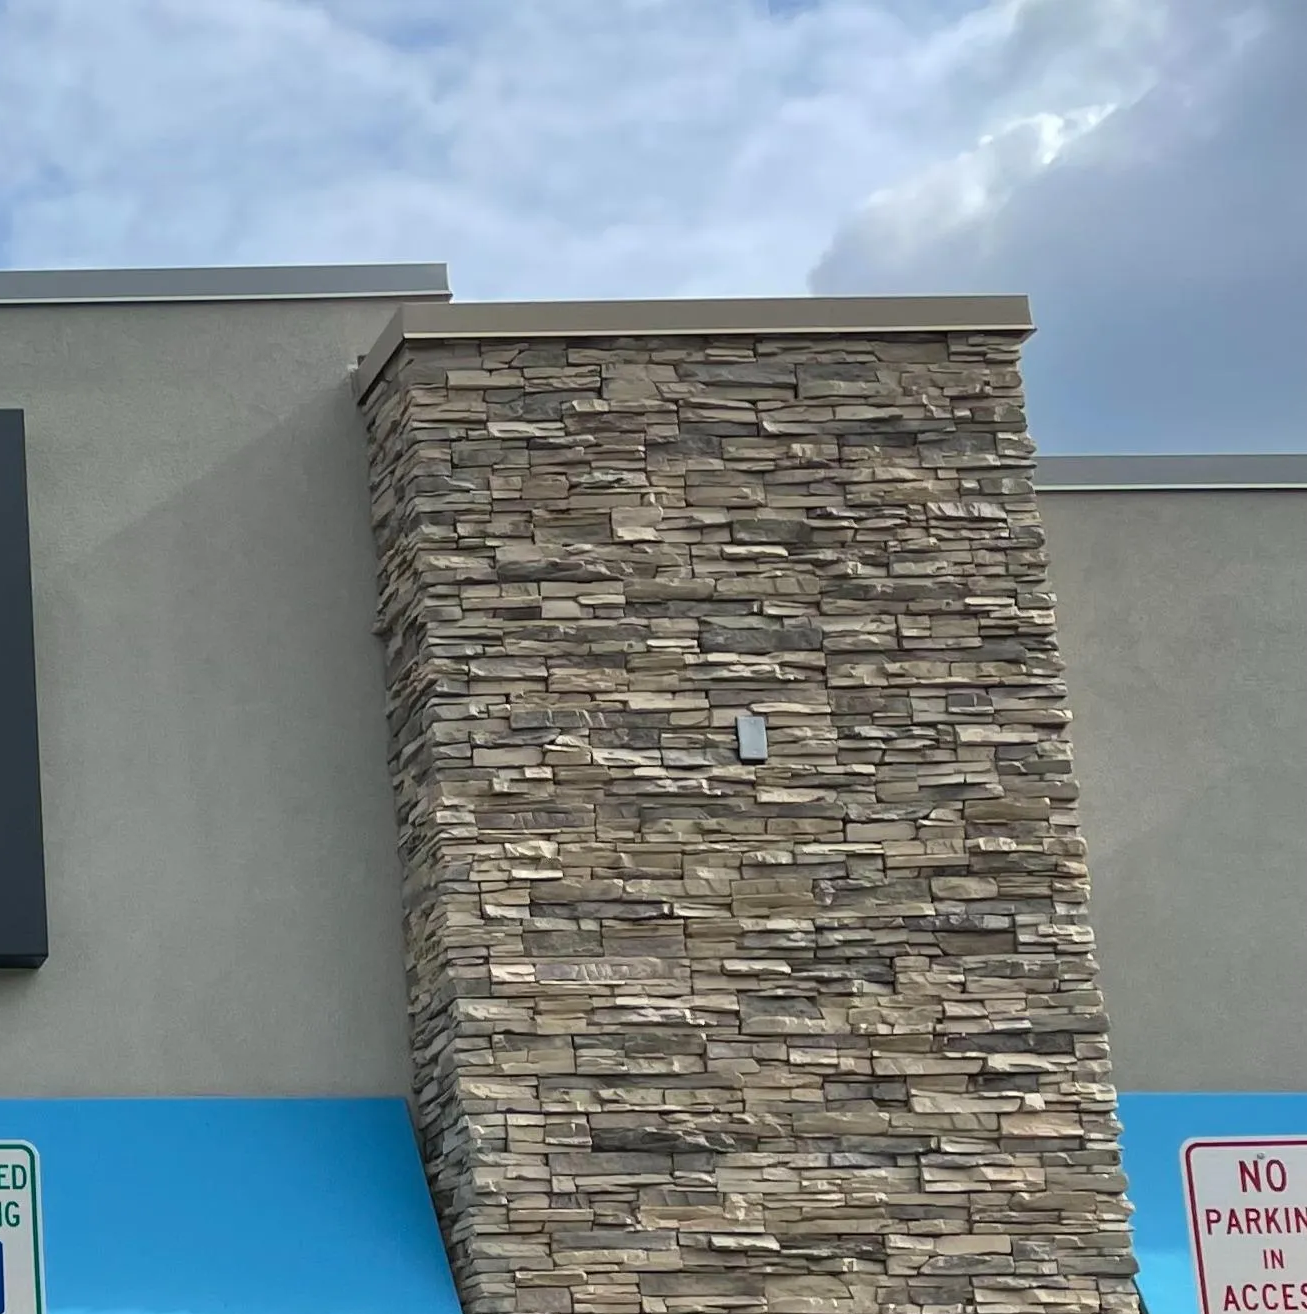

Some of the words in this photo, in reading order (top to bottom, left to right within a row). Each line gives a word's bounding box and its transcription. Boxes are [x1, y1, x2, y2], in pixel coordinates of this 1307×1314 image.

[1238, 1159, 1287, 1193] NO
[1205, 1206, 1307, 1235] PARKIN
[1263, 1249, 1285, 1269] IN
